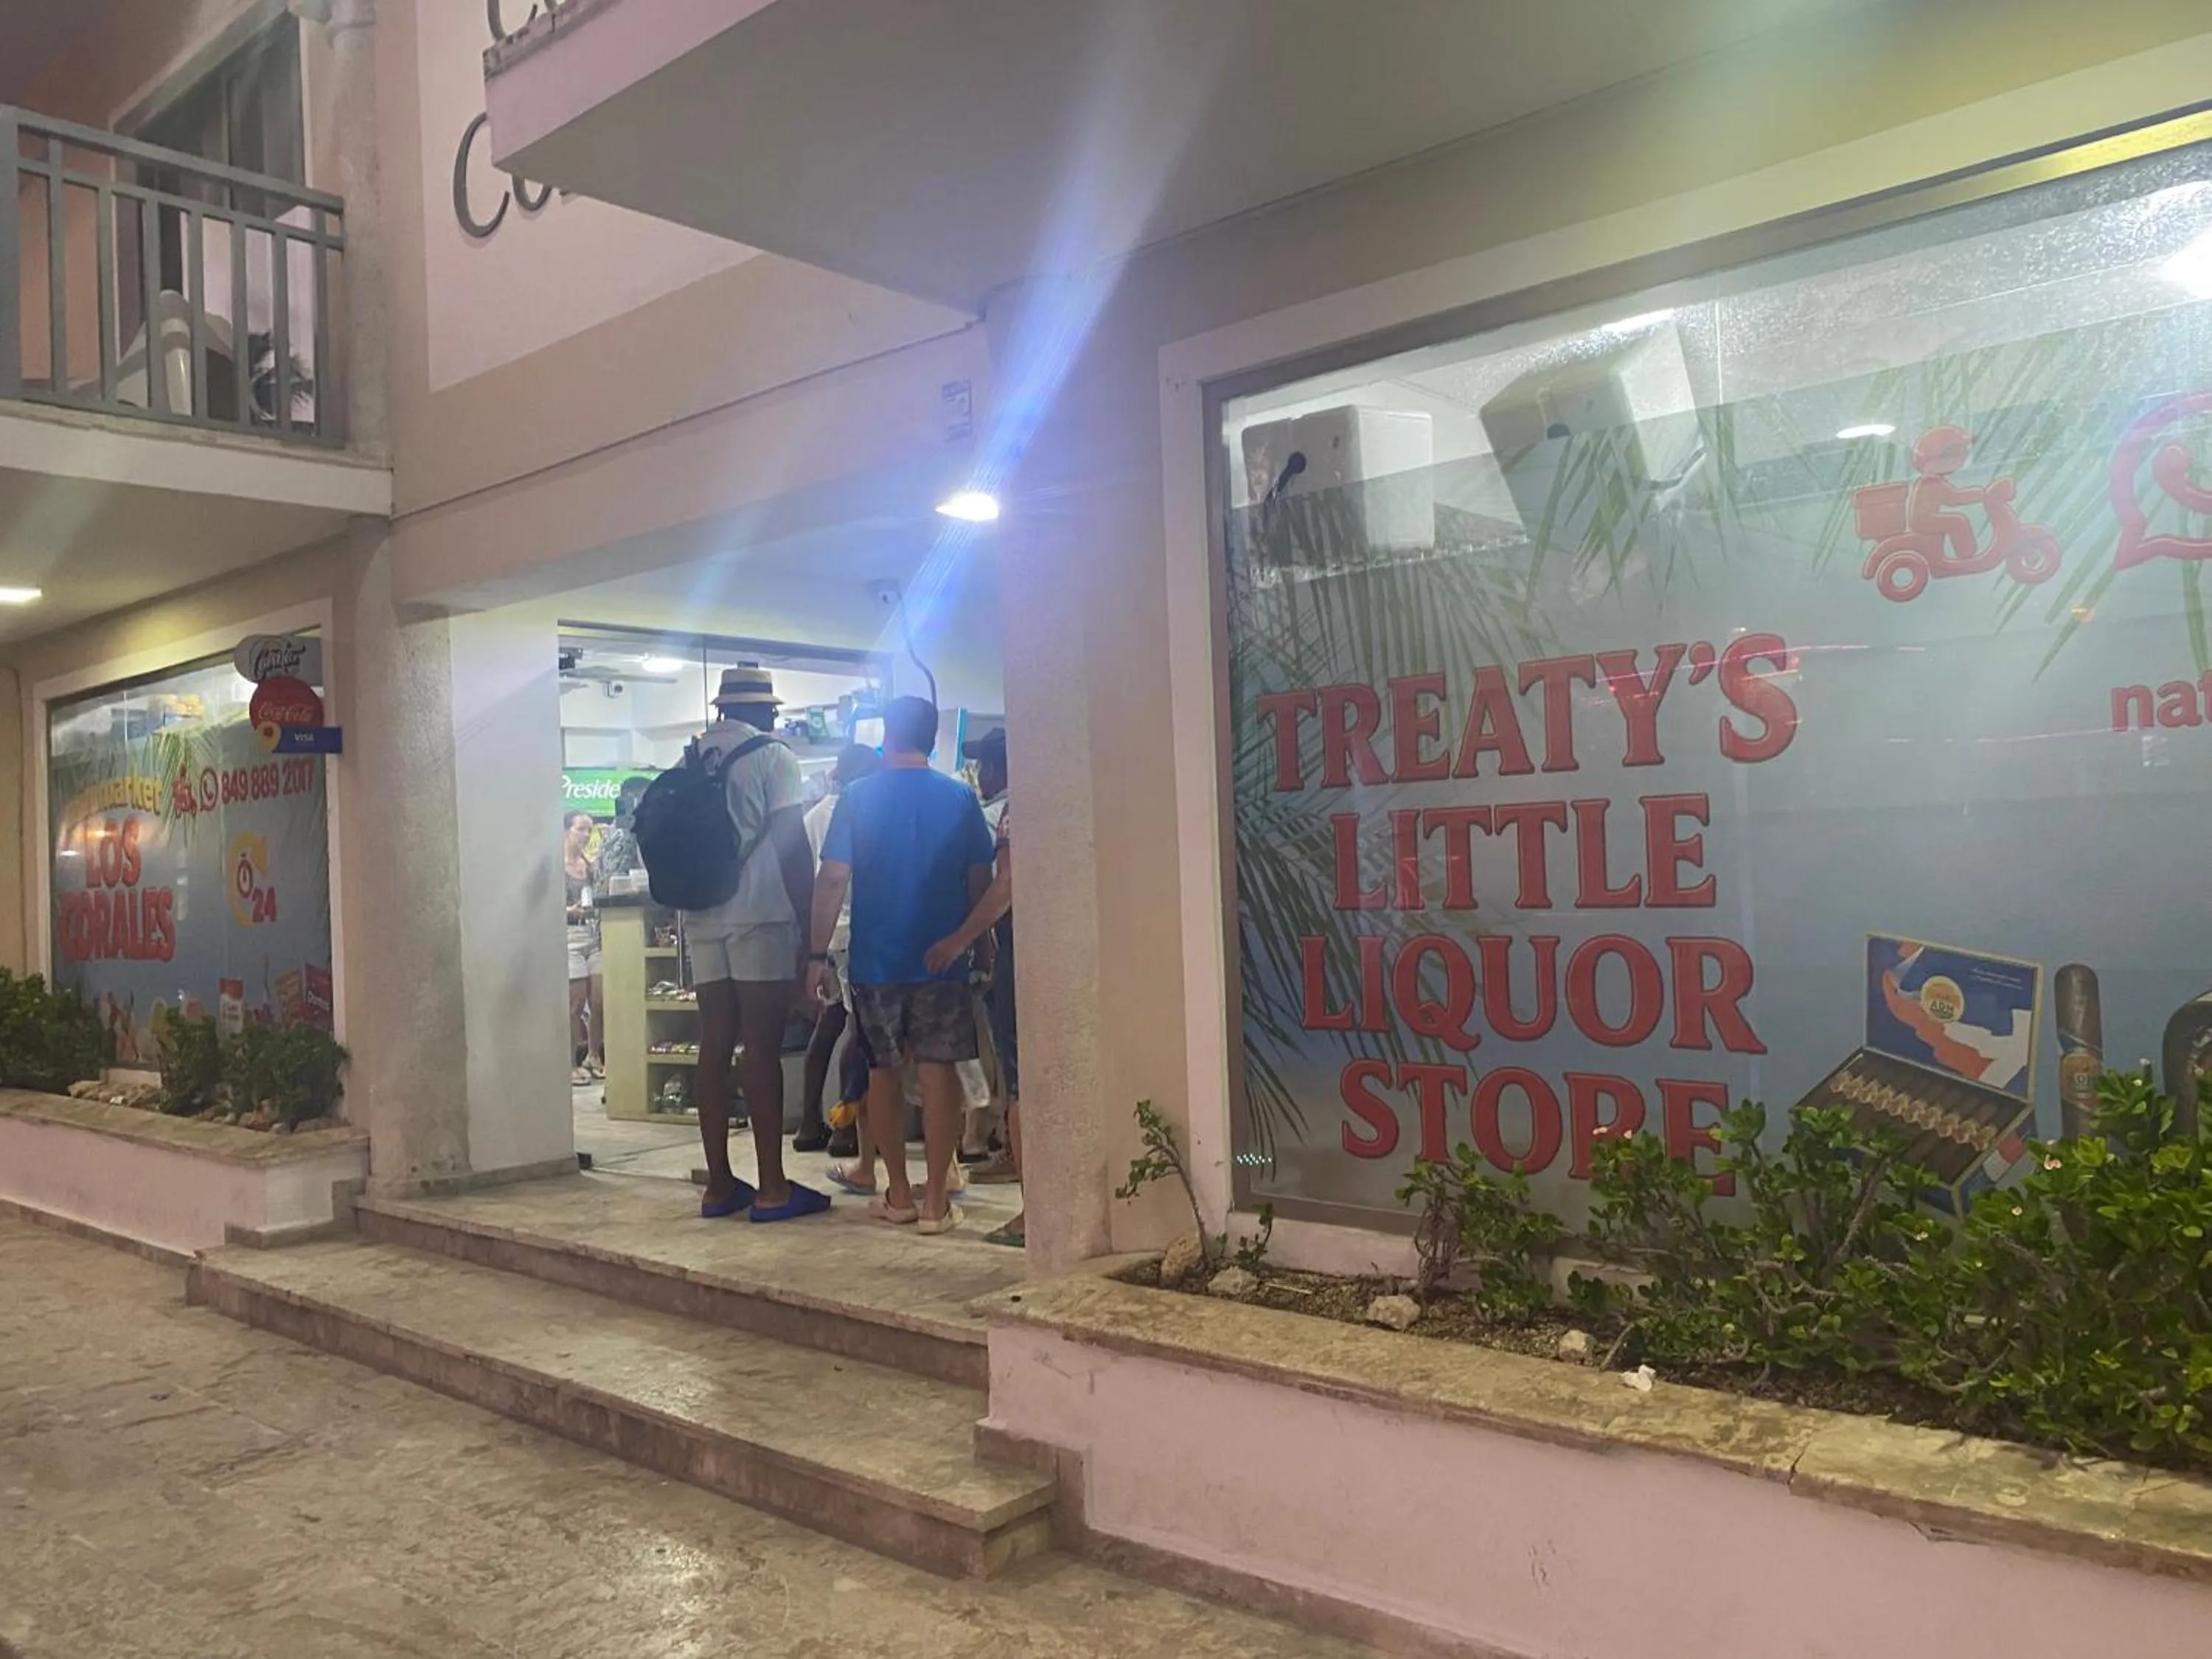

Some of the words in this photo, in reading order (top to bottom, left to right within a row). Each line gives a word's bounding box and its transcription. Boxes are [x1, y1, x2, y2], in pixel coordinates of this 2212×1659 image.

[1256, 633, 1799, 792] TREATY'S
[221, 770, 248, 804] 849
[251, 762, 279, 801] 889
[85, 814, 141, 888] LOS
[1330, 793, 1717, 911] LITTLE
[252, 886, 277, 923] 24
[1299, 933, 1768, 1054] LIQUOR
